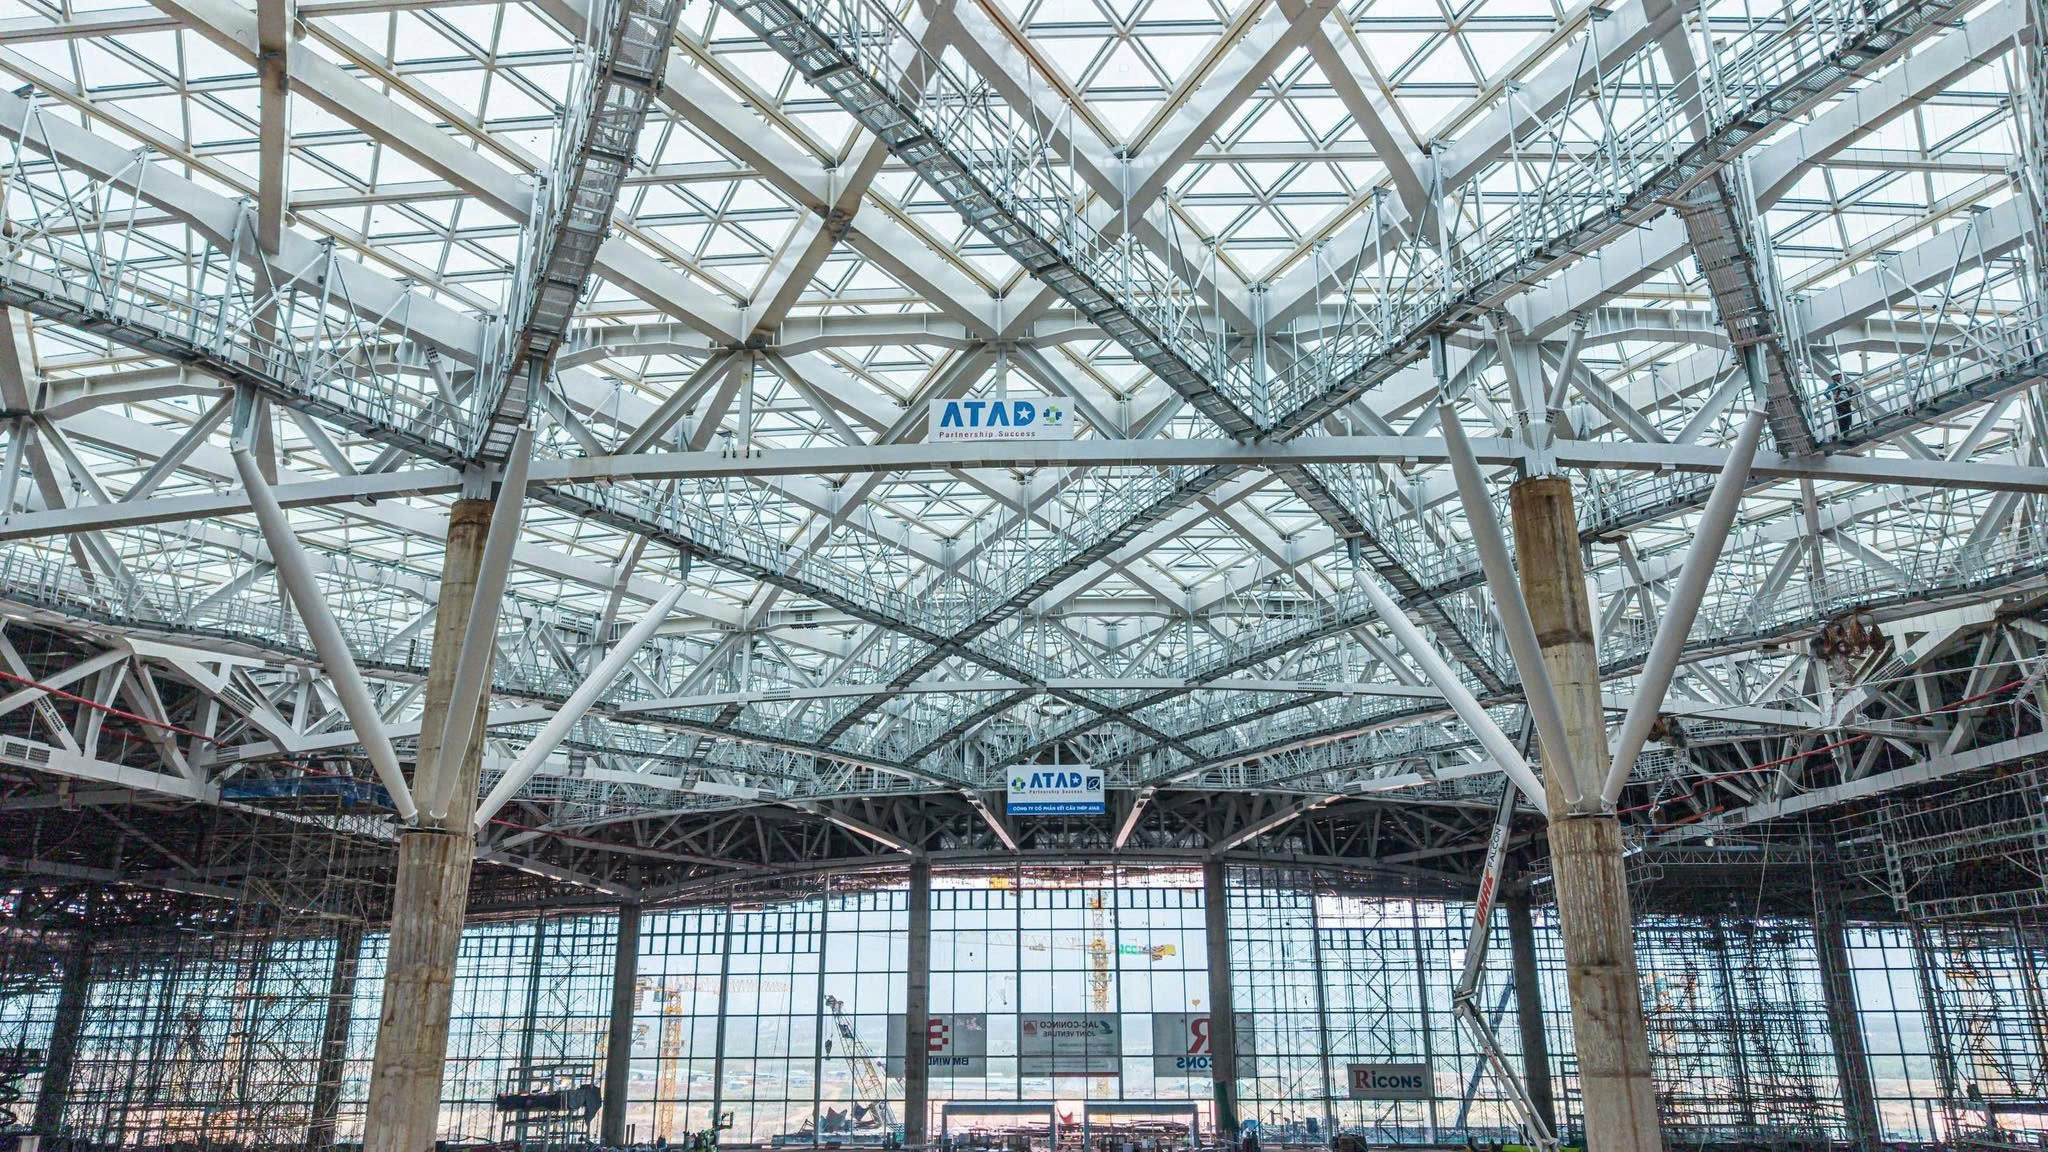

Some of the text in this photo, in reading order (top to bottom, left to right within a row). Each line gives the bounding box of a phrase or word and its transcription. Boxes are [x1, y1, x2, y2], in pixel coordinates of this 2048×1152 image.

[940, 401, 1036, 427] ATAD
[939, 430, 1036, 440] Partnership Success
[1030, 772, 1082, 788] ATAD
[1487, 827, 1502, 868] FALCON
